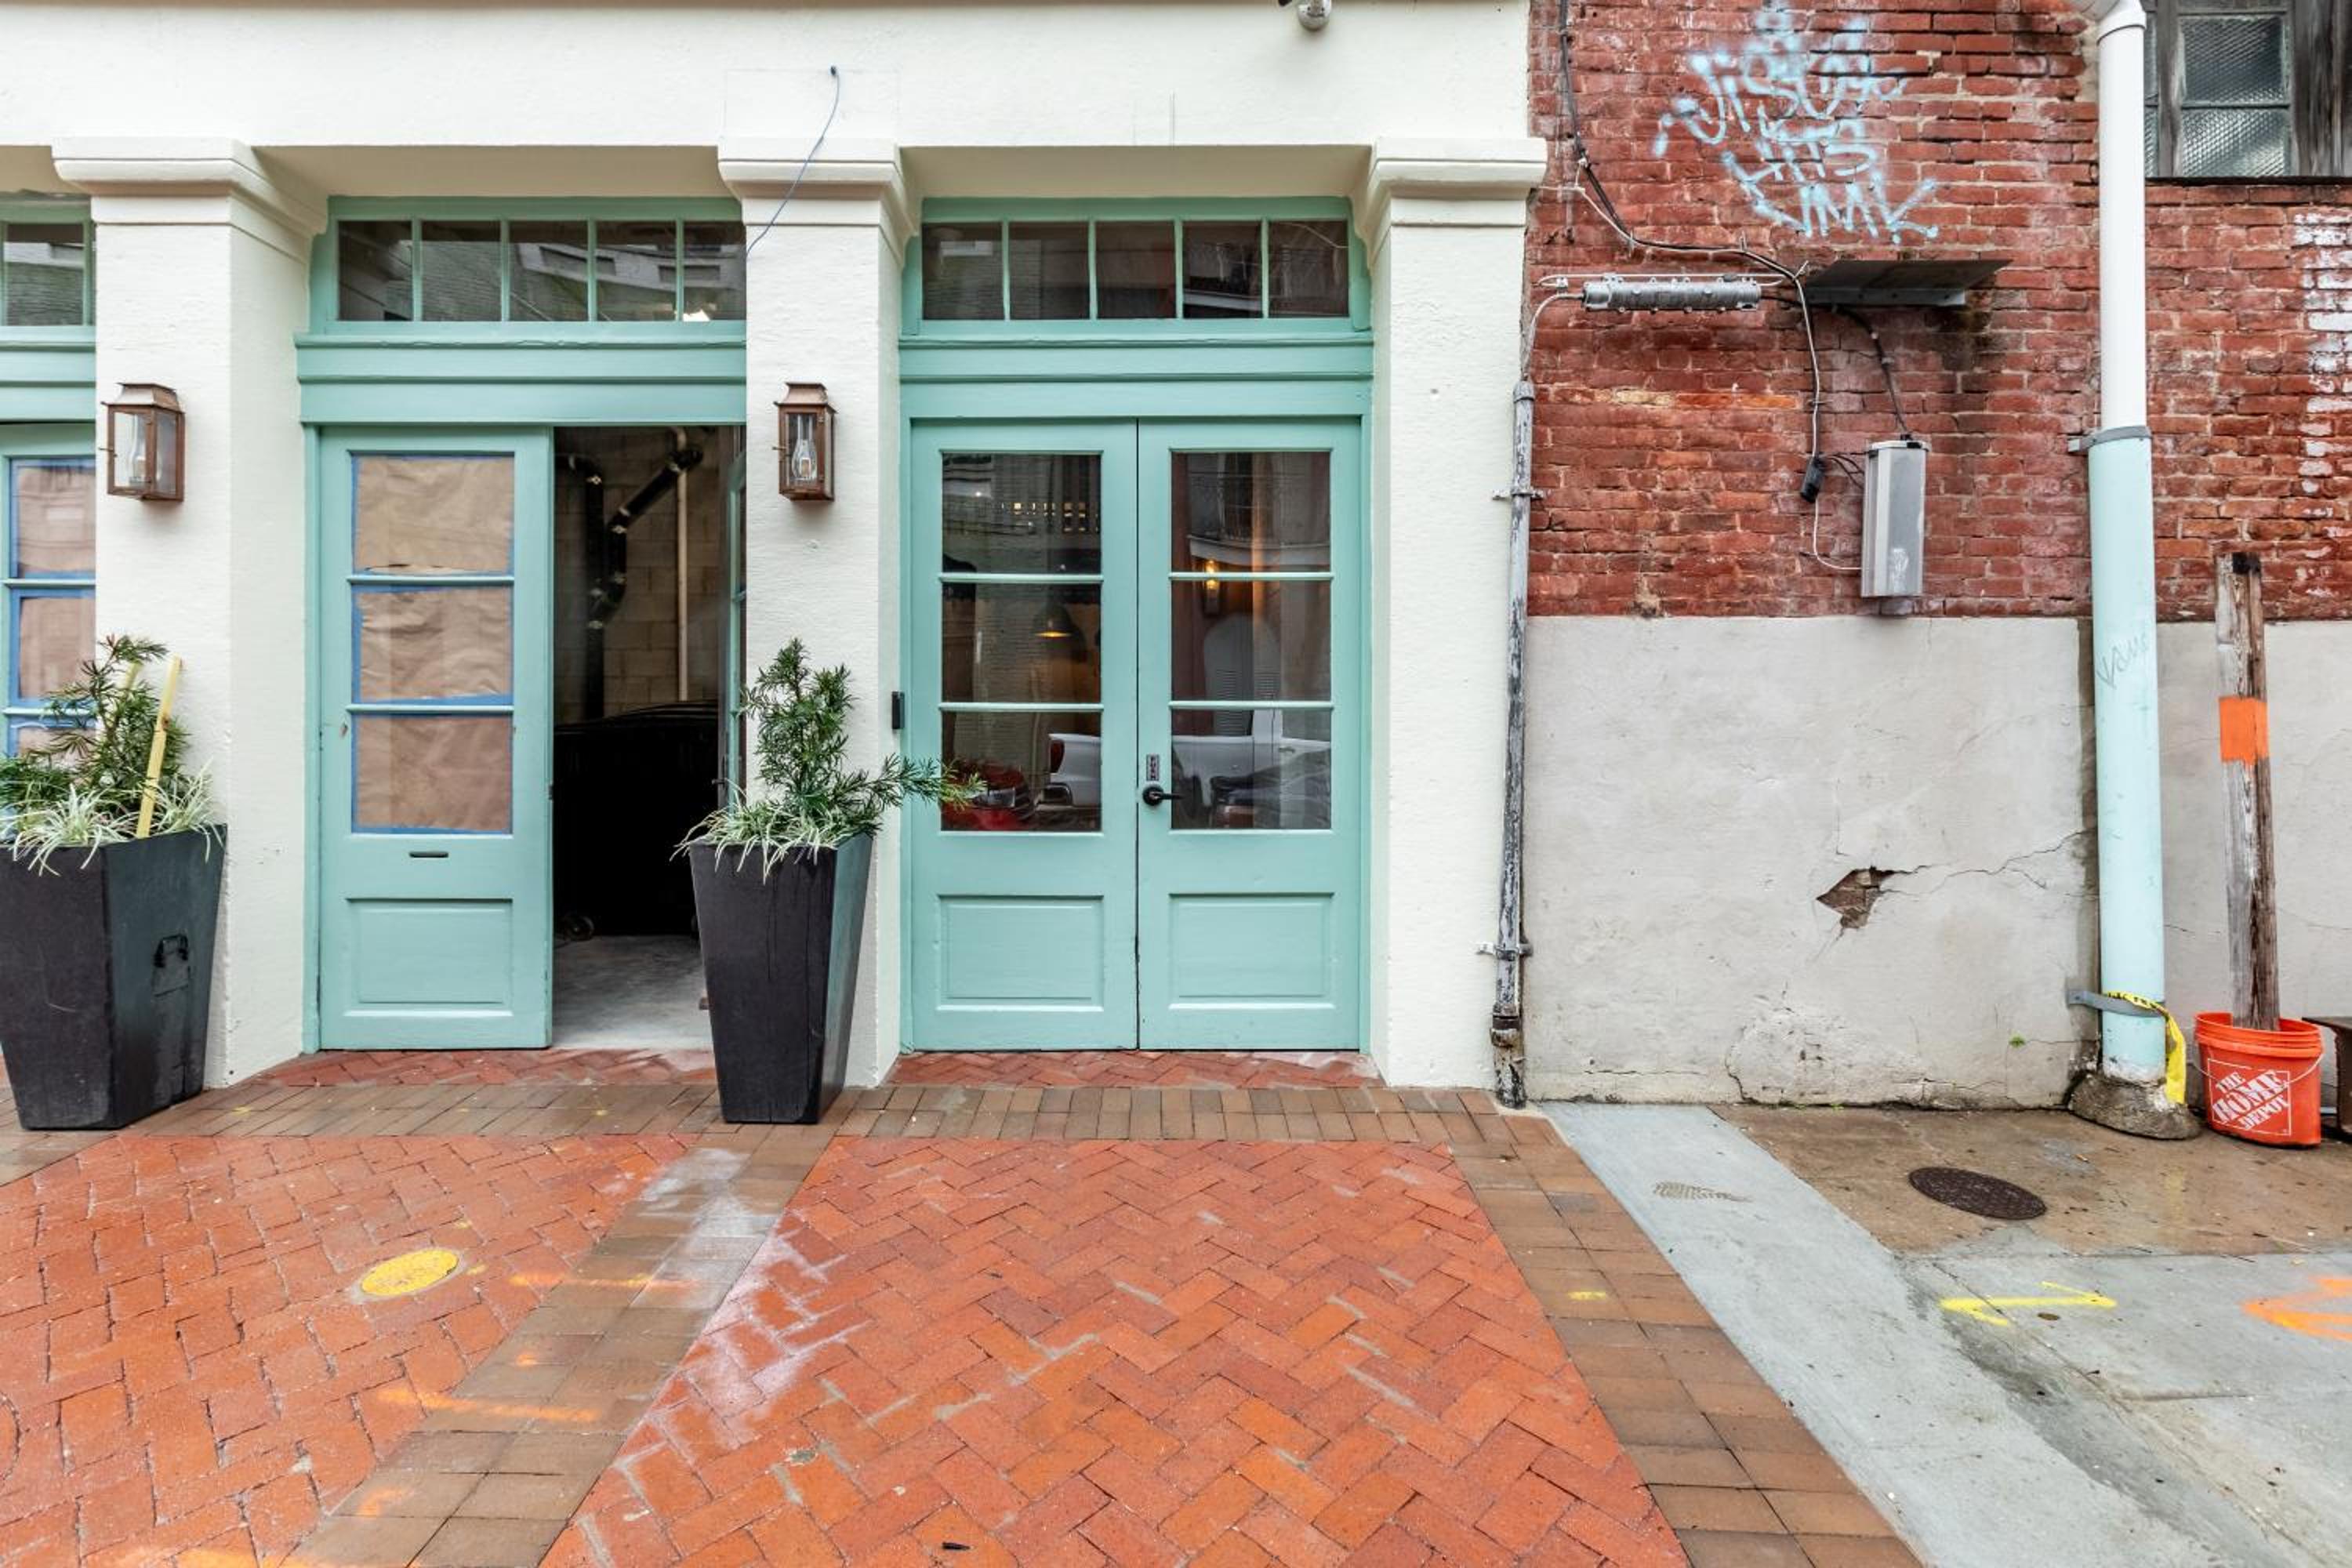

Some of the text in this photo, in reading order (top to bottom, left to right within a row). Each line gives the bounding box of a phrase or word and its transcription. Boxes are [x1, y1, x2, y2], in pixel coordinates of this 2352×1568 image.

[2212, 1070, 2288, 1123] HOME
[2216, 1072, 2245, 1094] THE
[2238, 1094, 2288, 1130] DEPOT
